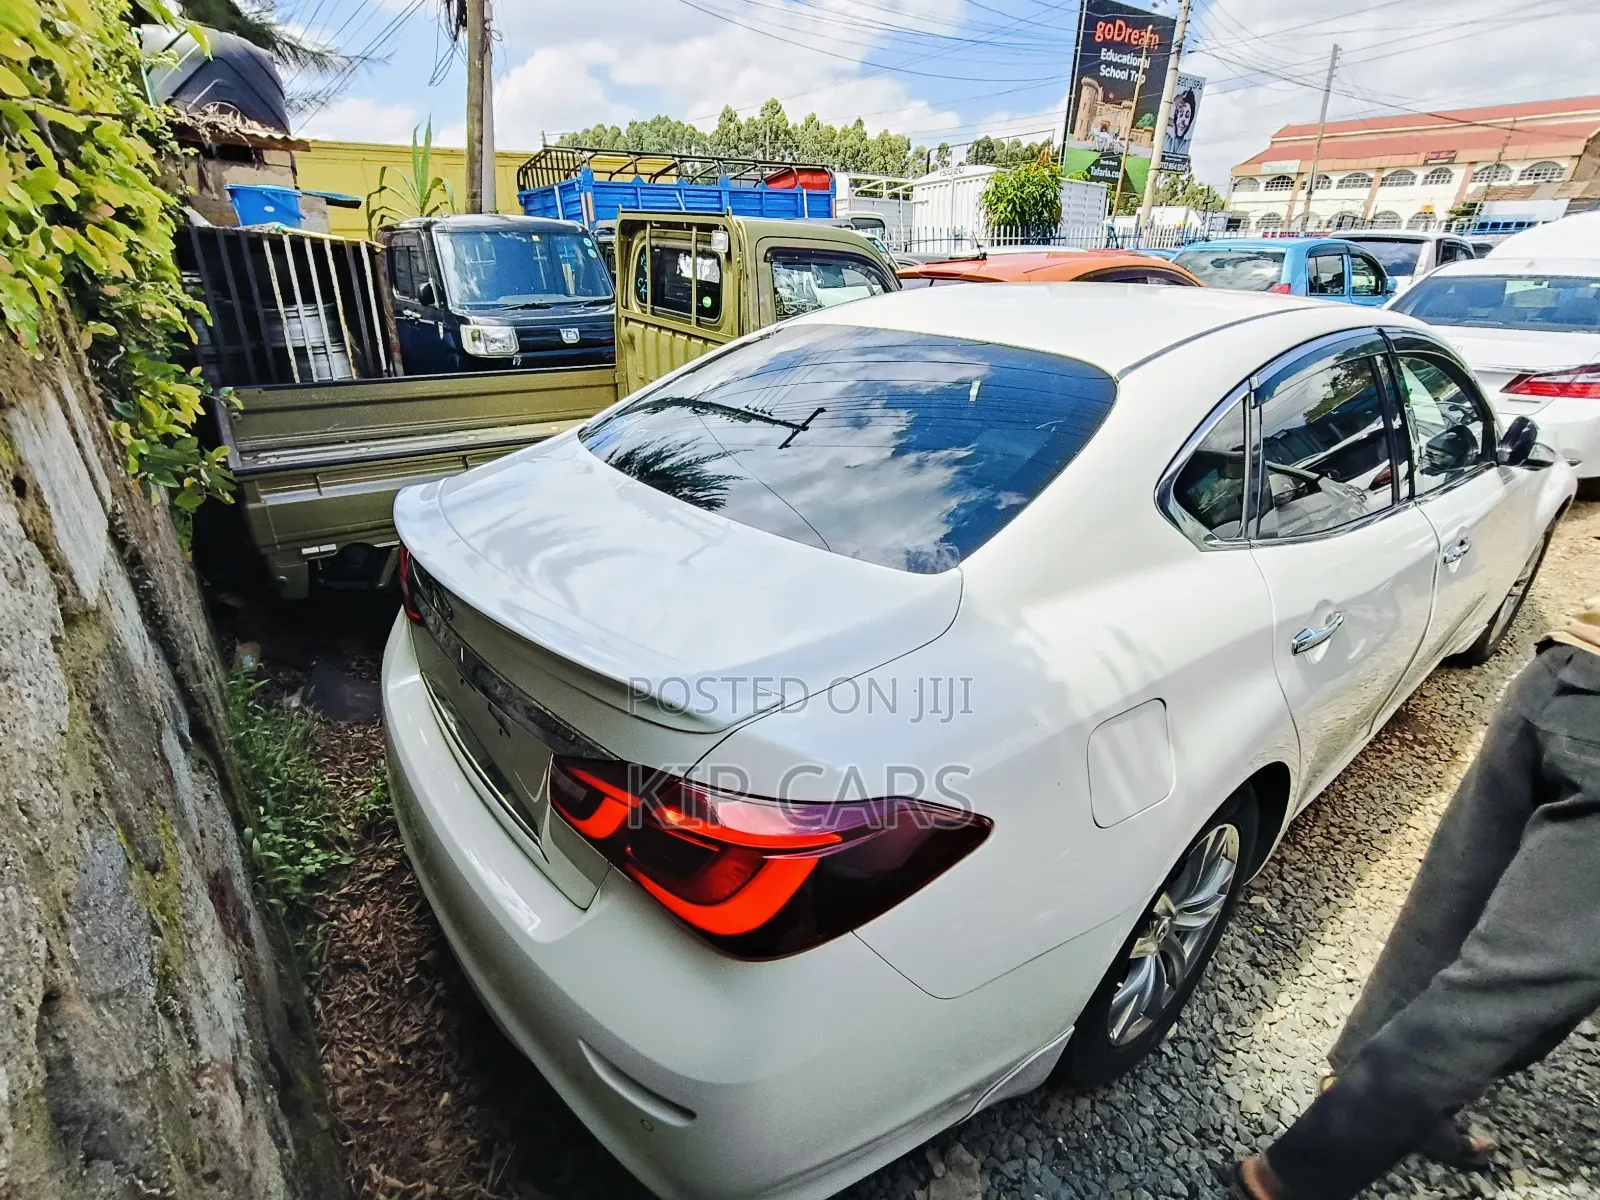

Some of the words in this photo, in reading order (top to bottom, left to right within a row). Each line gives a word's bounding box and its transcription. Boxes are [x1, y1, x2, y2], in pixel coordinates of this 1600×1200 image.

[1095, 19, 1160, 49] goDream
[1100, 47, 1151, 69] Educational
[1100, 64, 1129, 81] School
[1129, 70, 1146, 85] Trp
[939, 167, 965, 177] ISUZU
